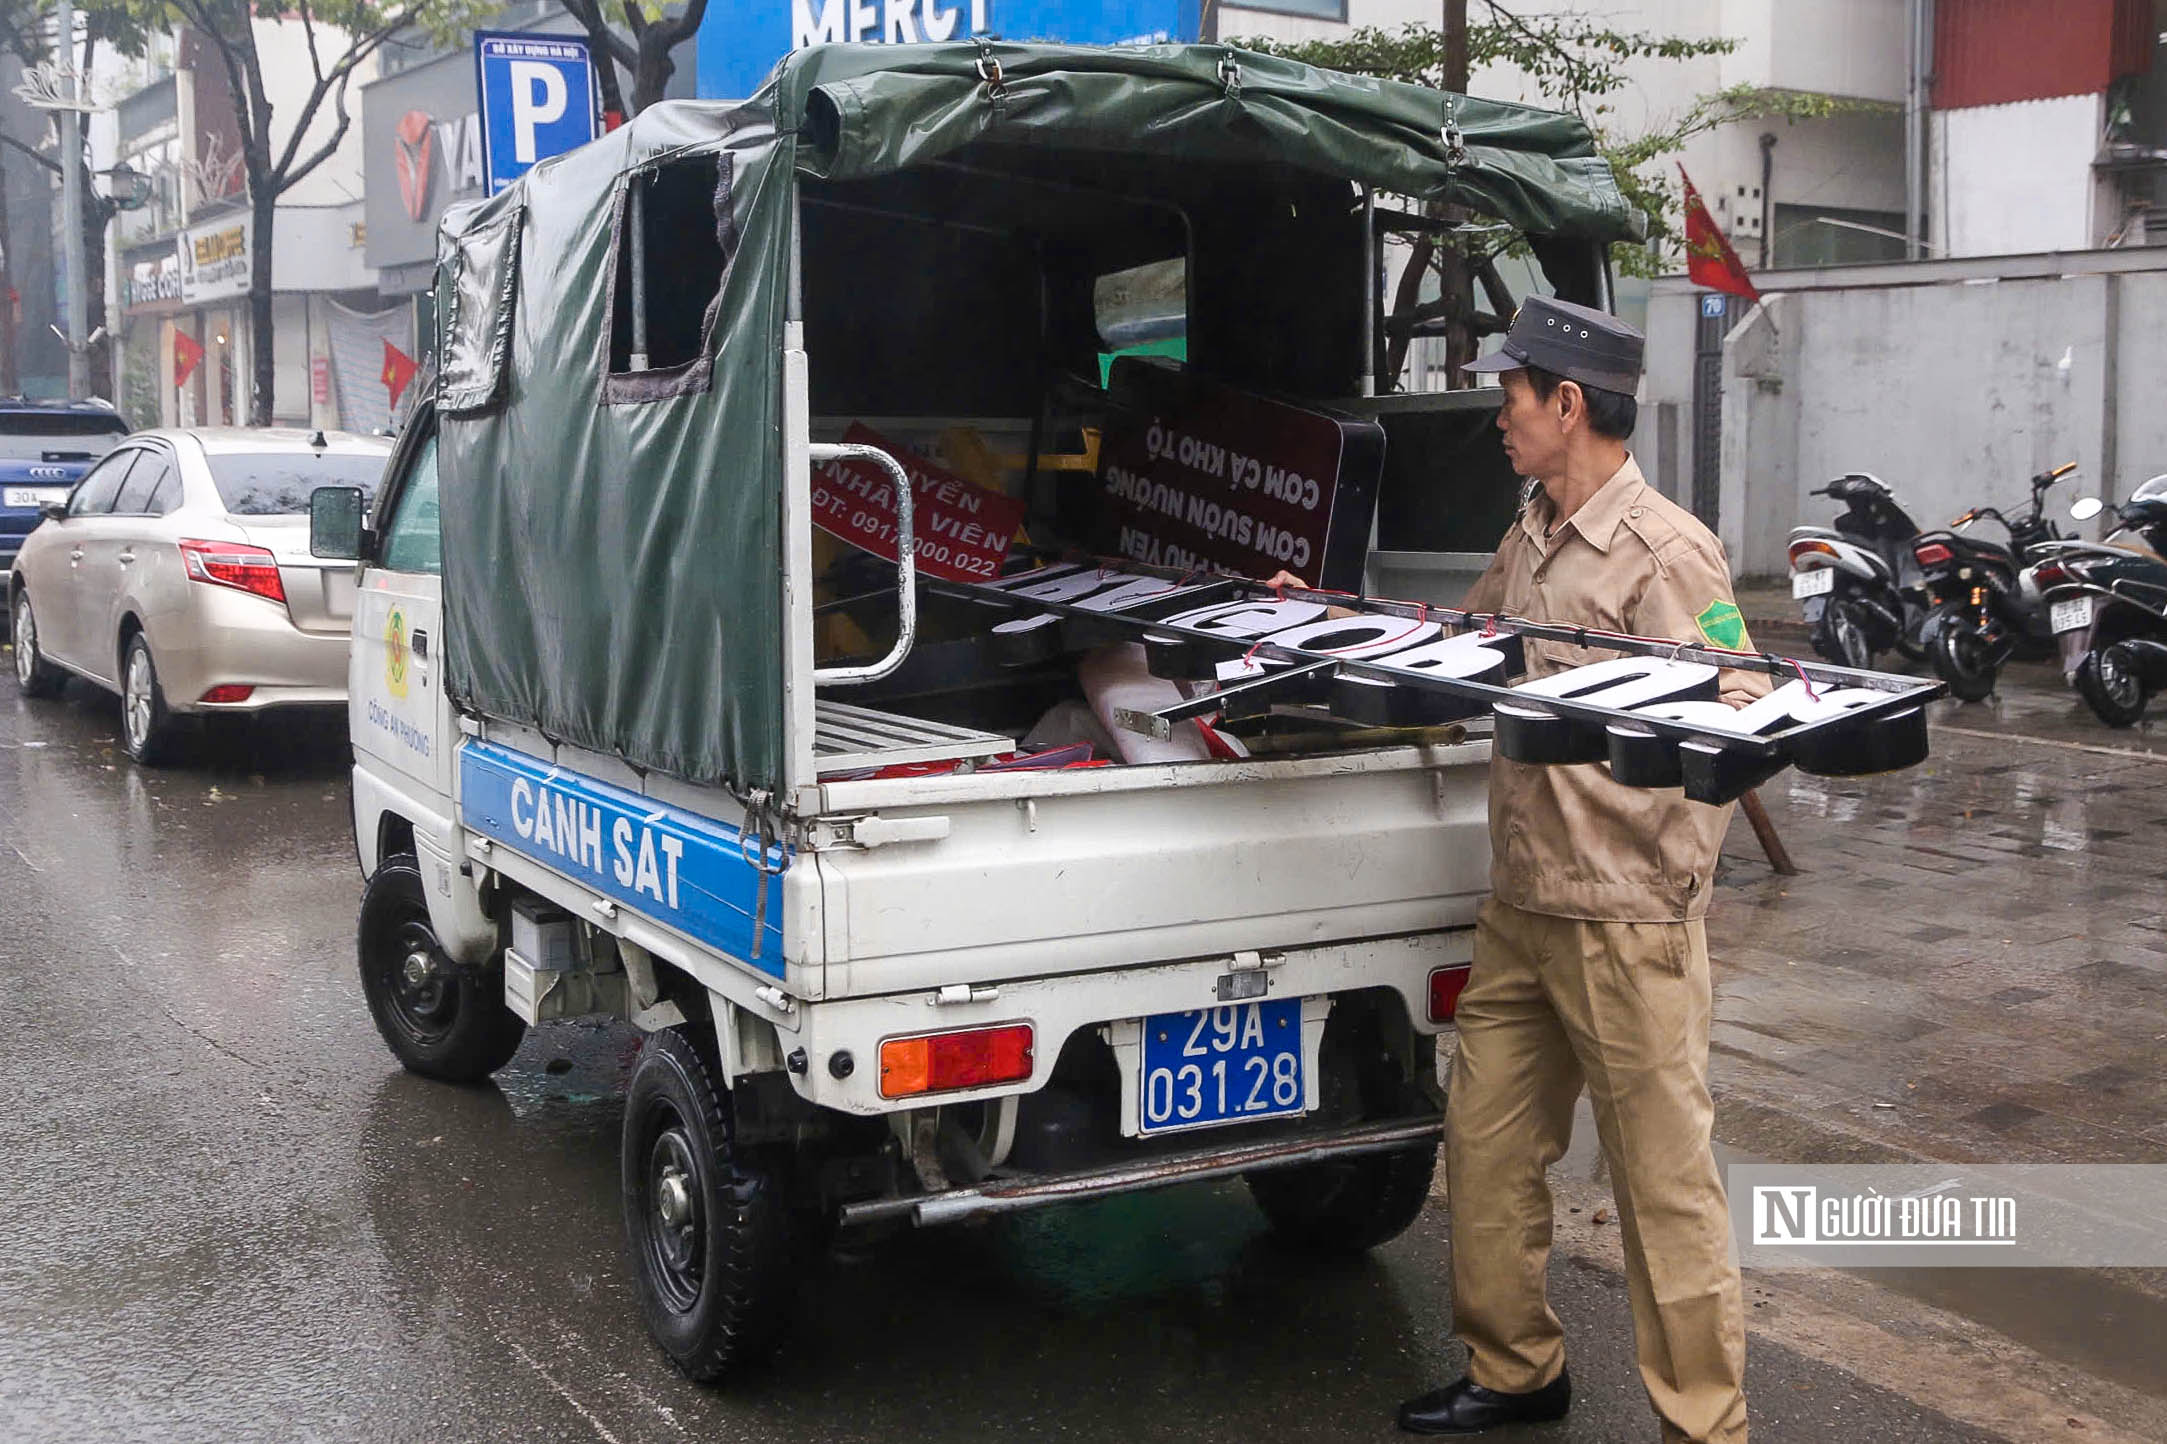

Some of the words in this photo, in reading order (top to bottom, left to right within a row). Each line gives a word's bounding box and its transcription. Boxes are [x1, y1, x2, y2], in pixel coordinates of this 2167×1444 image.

[510, 60, 568, 164] P
[1179, 436, 1225, 477] KHO
[1230, 452, 1261, 490] CÁ
[1264, 465, 1320, 510] CƠM
[930, 511, 1008, 552] VIÊN
[1187, 495, 1254, 546] SƯỜN
[1255, 521, 1311, 568] CƠM
[510, 767, 604, 875] CẢNH
[613, 810, 683, 910] SÁT
[1183, 1003, 1265, 1057] 29A
[1148, 1052, 1298, 1122] 031.28
